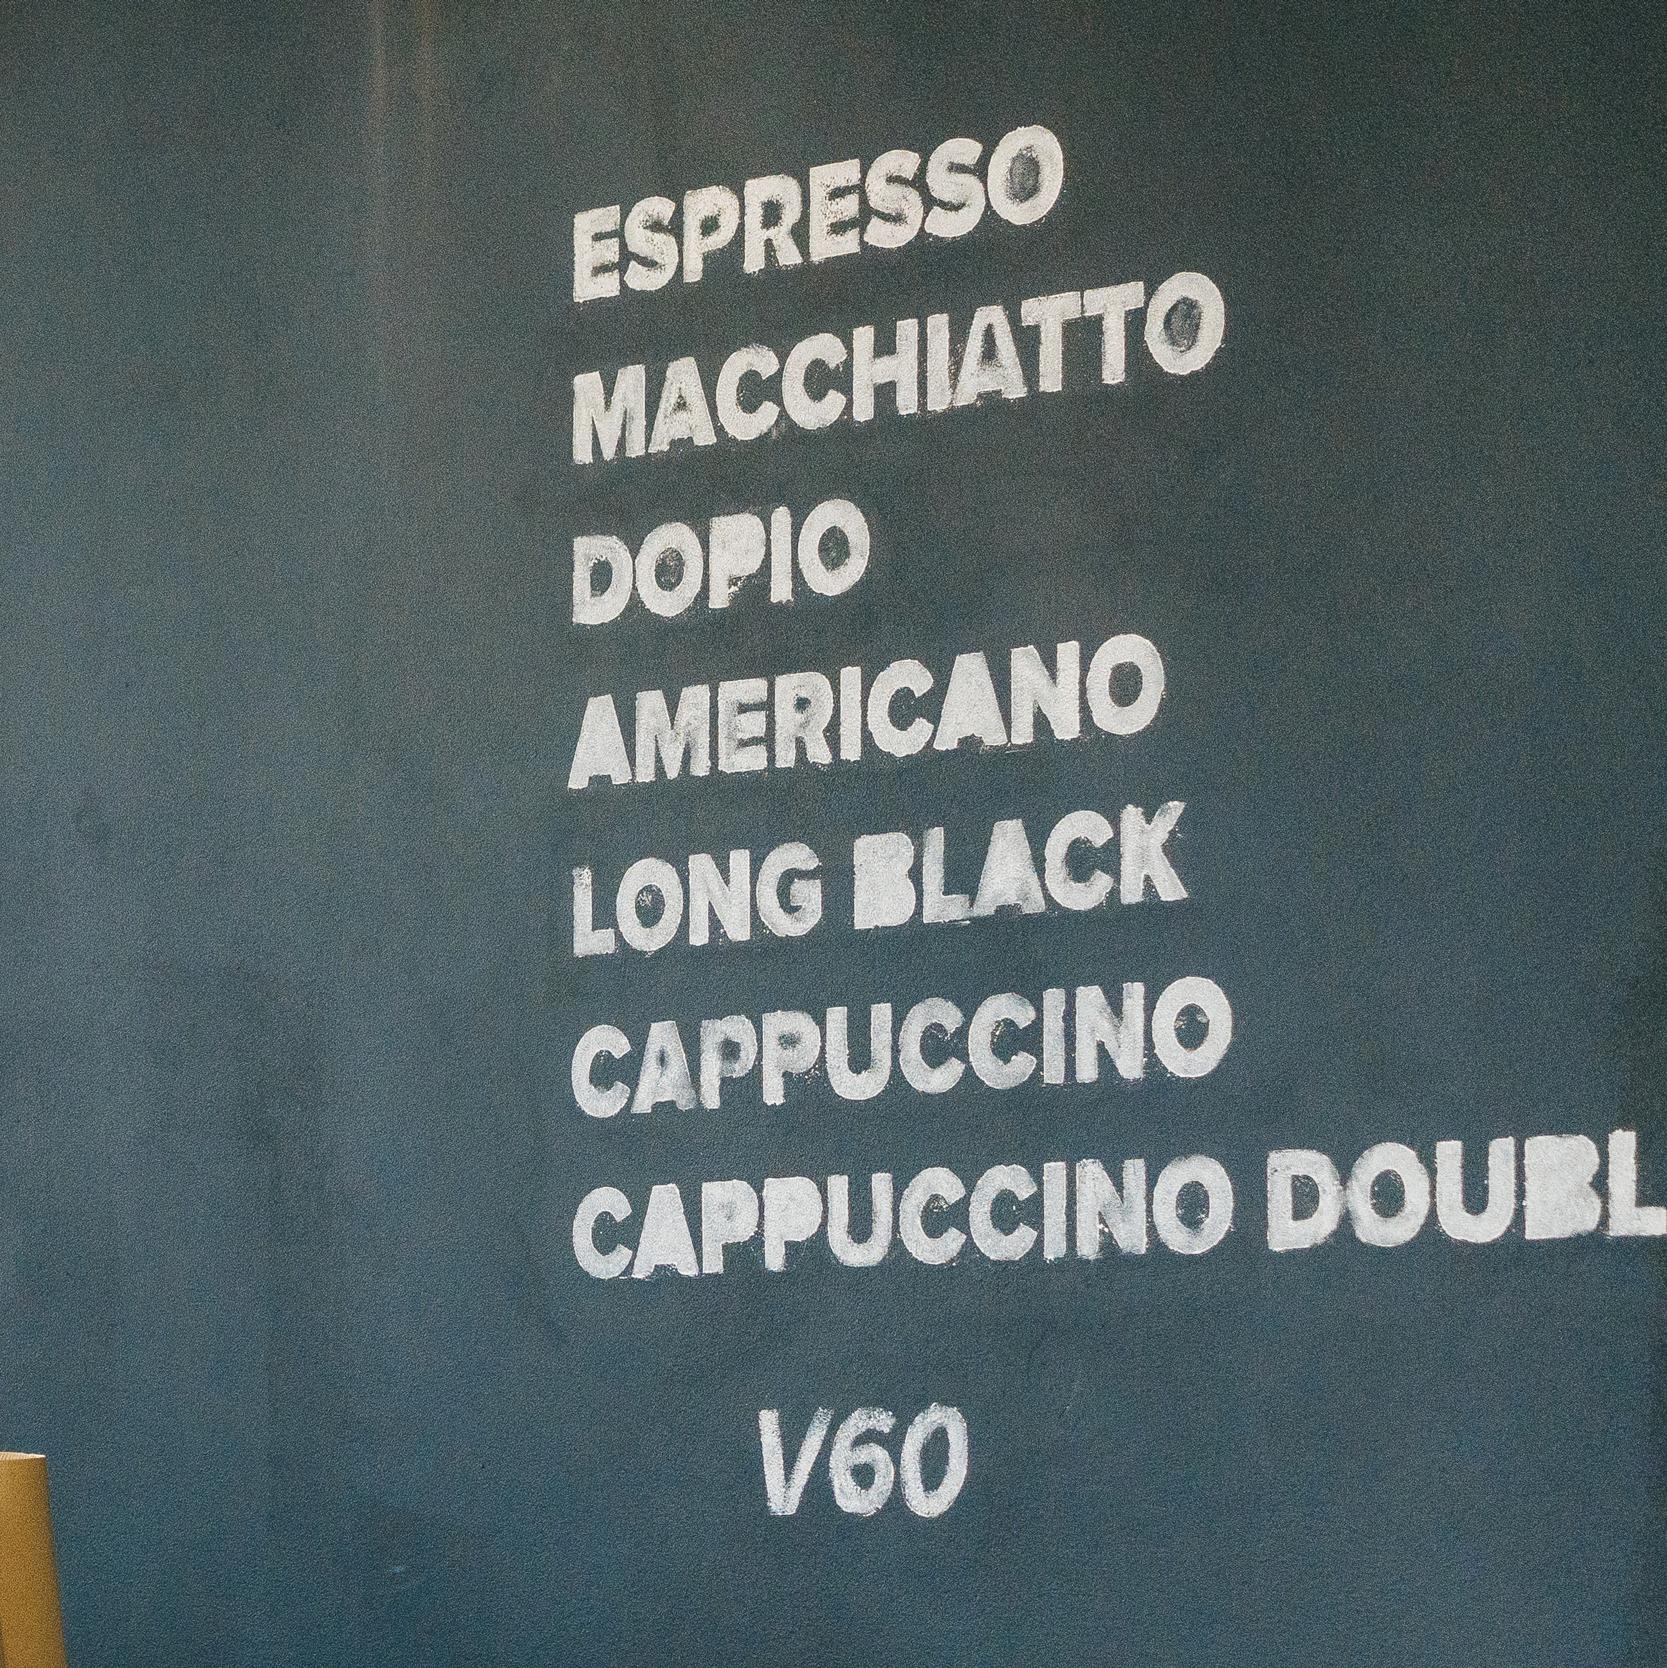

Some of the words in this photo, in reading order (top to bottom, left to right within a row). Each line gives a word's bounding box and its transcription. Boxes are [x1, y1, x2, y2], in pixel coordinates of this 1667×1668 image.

[572, 124, 1064, 303] ESPRESSO
[572, 271, 1226, 465] MACCHIATTO
[571, 498, 871, 625] DOPIO
[567, 632, 1166, 790] AMERICANO
[572, 841, 823, 957] LONG
[852, 800, 1189, 930] BLACK
[570, 975, 1234, 1119] CAPPUCCINO
[571, 1153, 1235, 1280] CAPPUCCINO
[1266, 1128, 1667, 1253] DOUBL
[758, 1402, 970, 1518] V60
